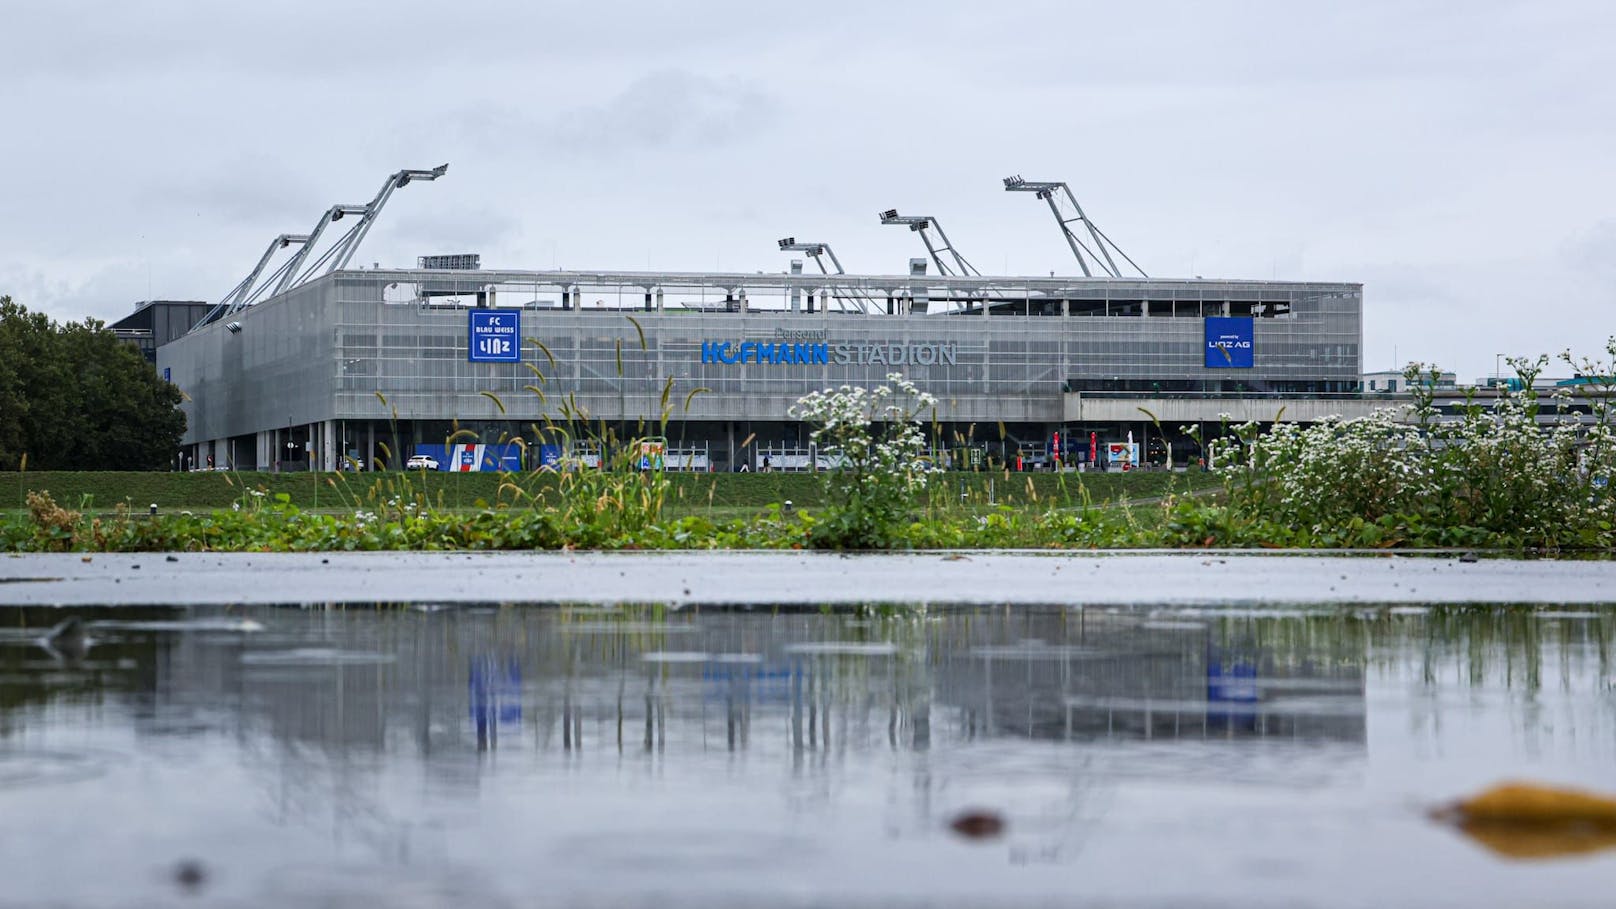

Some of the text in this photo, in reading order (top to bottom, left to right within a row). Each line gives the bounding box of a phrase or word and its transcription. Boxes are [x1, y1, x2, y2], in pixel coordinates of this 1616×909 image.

[489, 317, 501, 326] FC
[480, 338, 510, 354] LINZ
[701, 340, 958, 367] HOFMANN STADION
